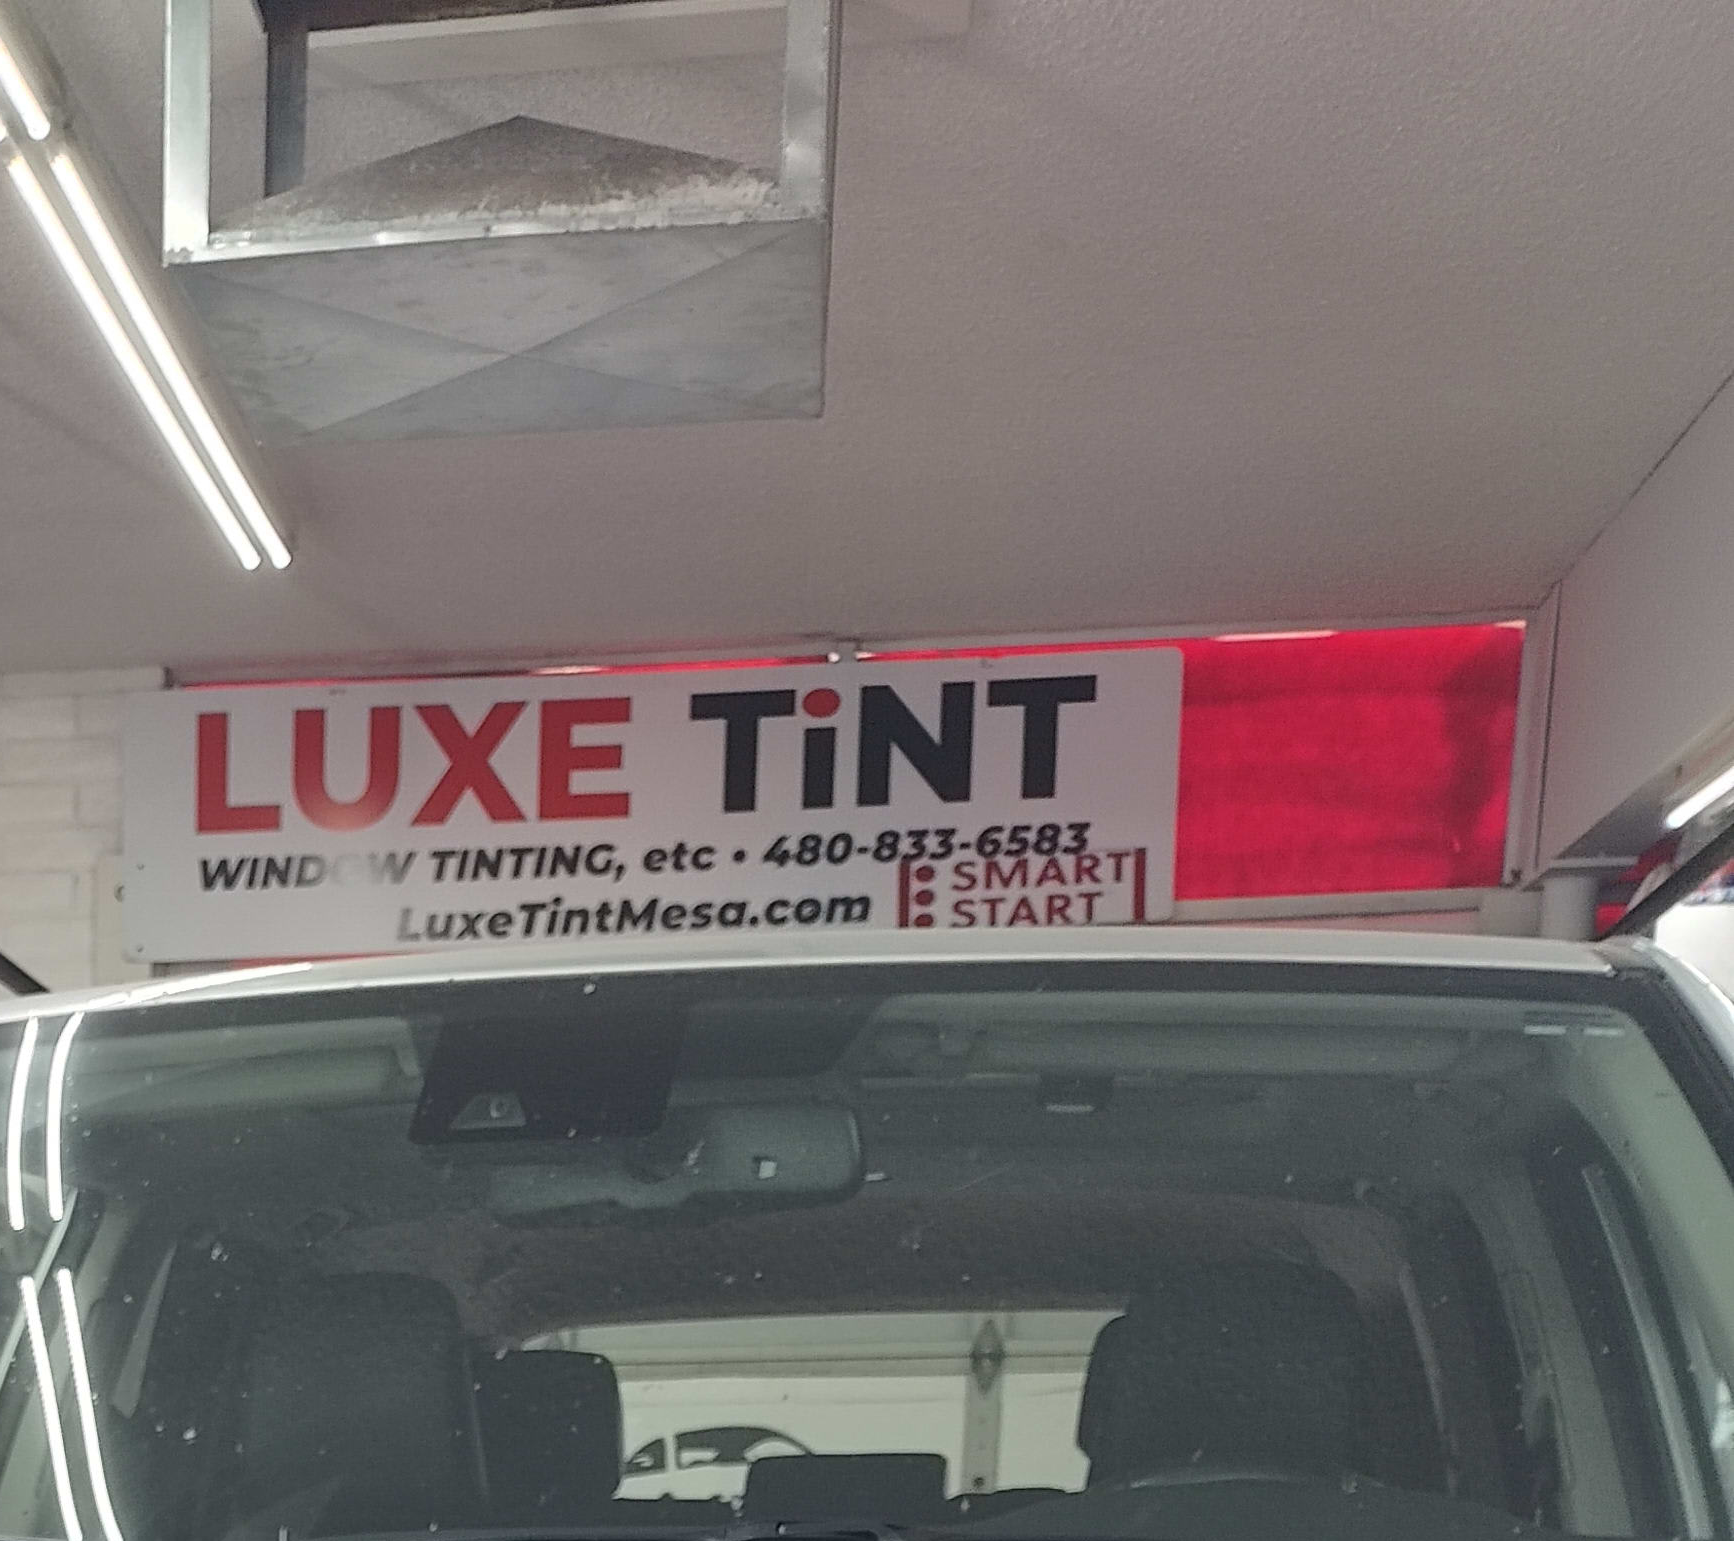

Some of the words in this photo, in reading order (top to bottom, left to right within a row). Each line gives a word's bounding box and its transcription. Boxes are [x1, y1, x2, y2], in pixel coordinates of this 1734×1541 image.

[196, 696, 633, 834] LUXE
[690, 675, 1098, 813] TiNT
[200, 852, 416, 891] WINDW
[431, 843, 626, 882] TINTING,
[642, 841, 716, 873] etc
[762, 822, 1091, 868] 480-833-6583
[952, 853, 1131, 890] SMART
[397, 895, 871, 942] LuxeTintMesa.com
[952, 892, 1103, 927] START
